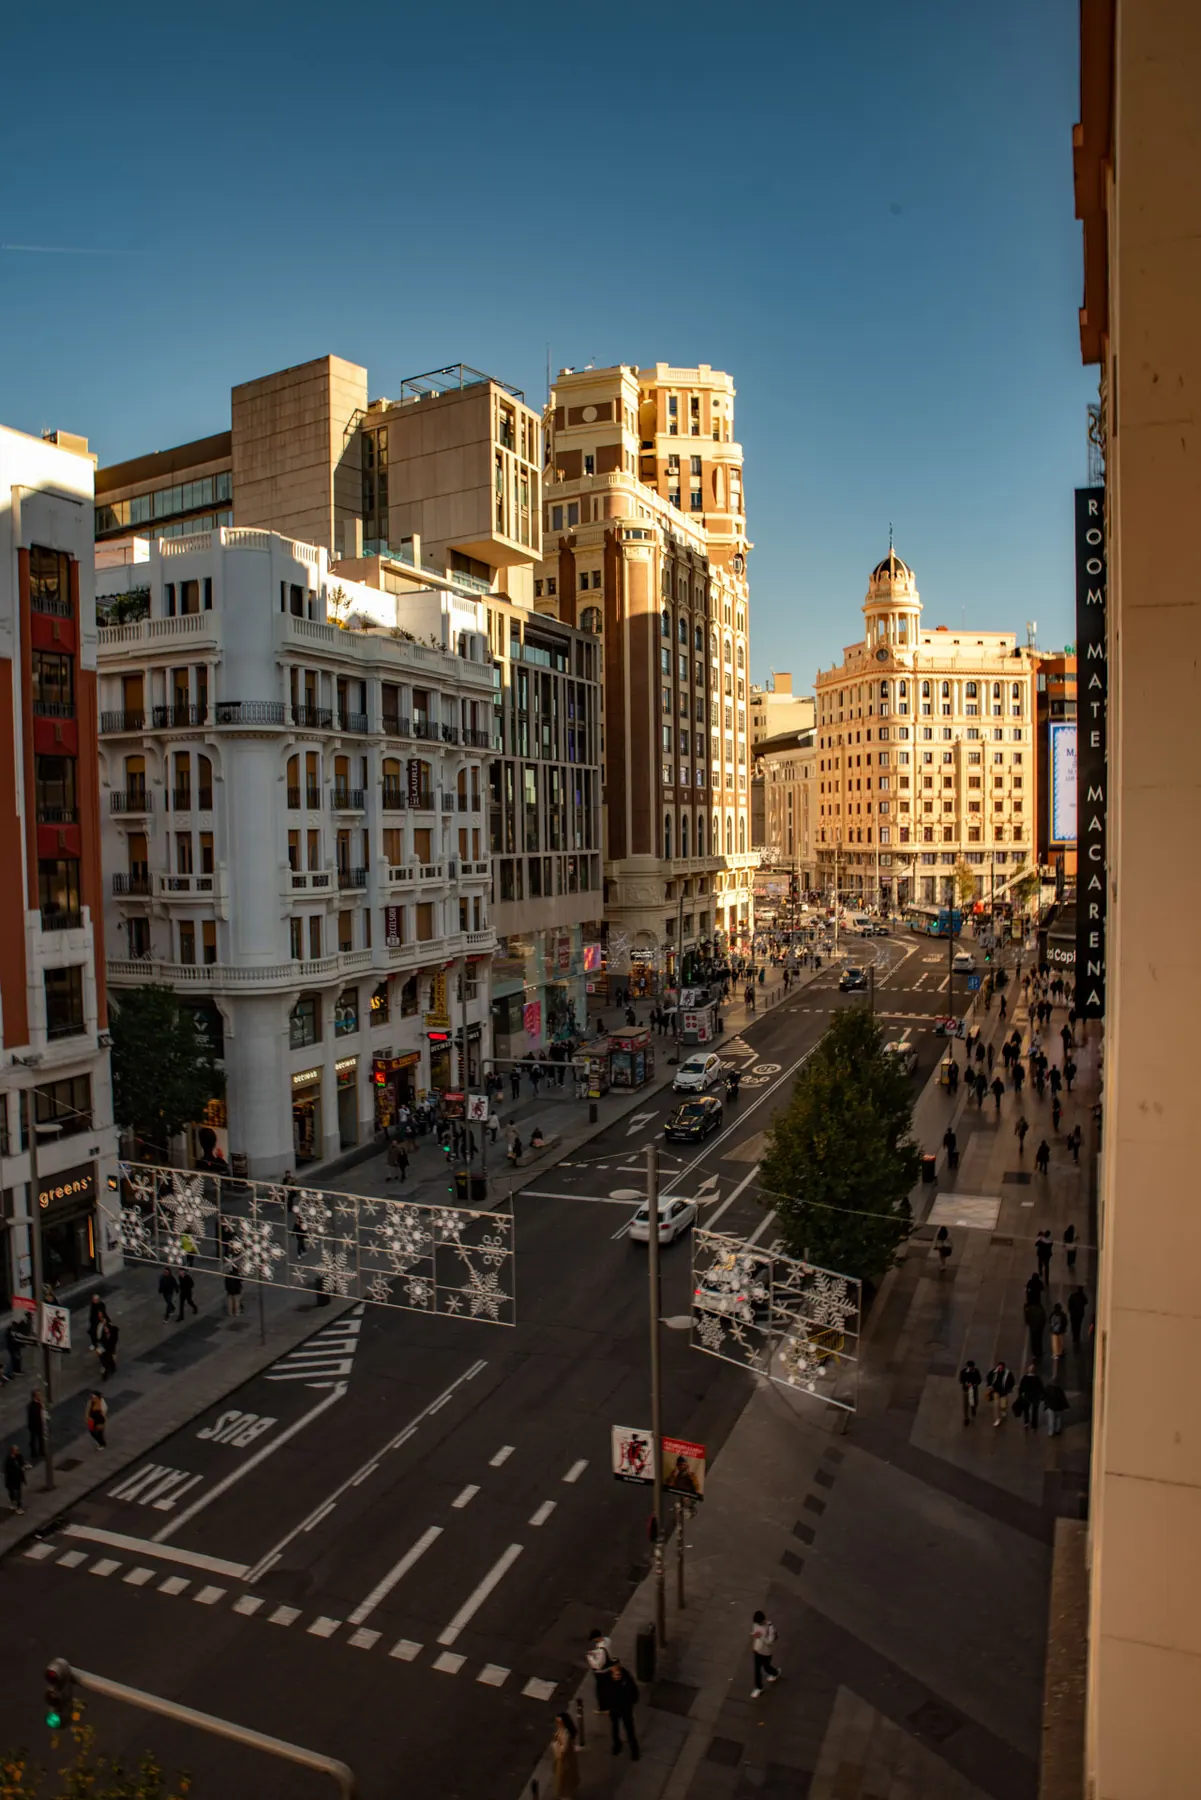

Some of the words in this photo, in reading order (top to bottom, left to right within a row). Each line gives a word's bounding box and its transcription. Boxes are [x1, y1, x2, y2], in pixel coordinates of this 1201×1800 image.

[1087, 499, 1103, 604] ROOM
[1088, 643, 1103, 748] MATE
[1087, 785, 1103, 1006] MACARENA
[196, 1409, 279, 1449] BUS
[106, 1462, 205, 1512] TAXI
